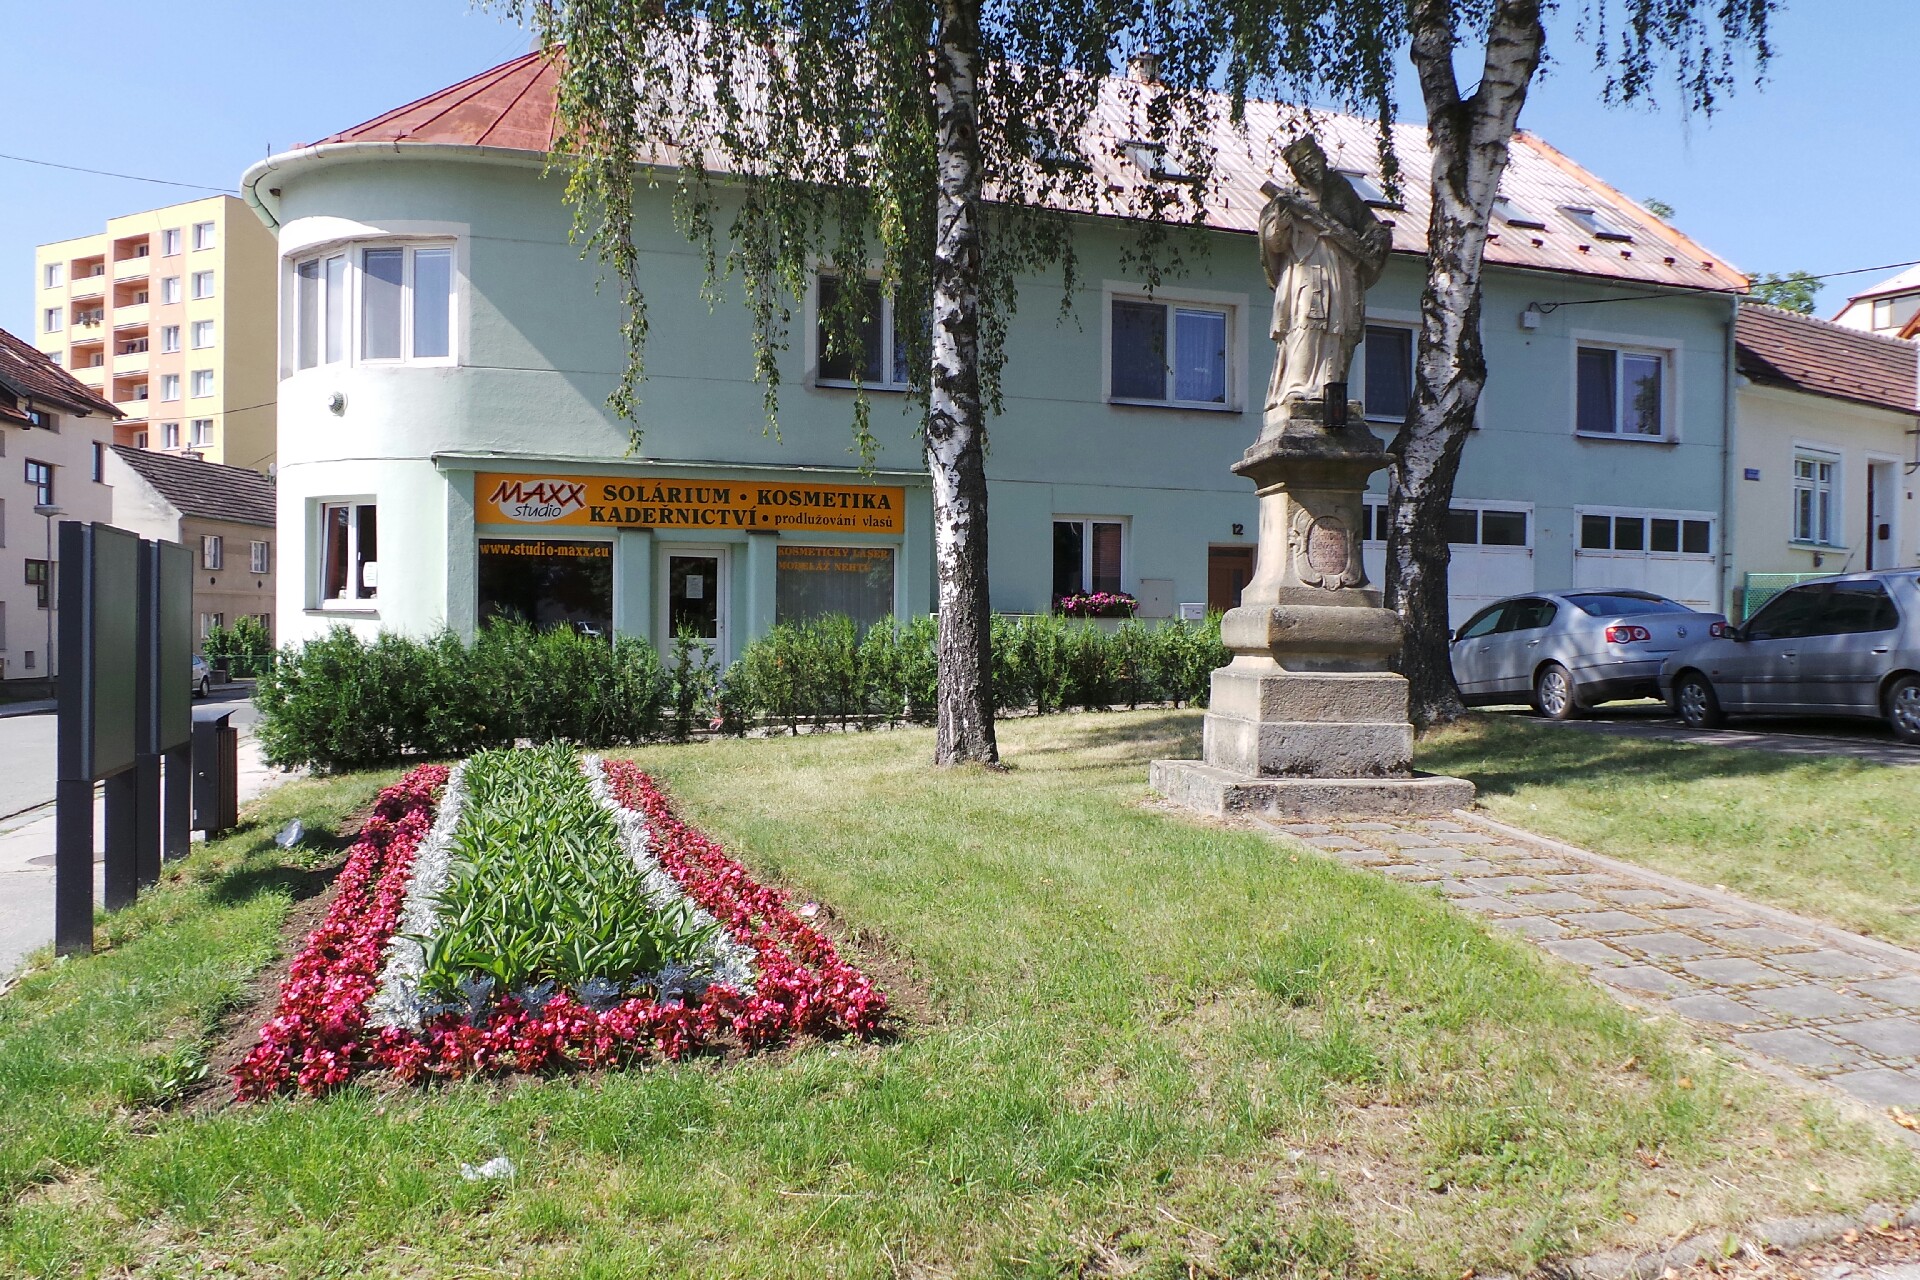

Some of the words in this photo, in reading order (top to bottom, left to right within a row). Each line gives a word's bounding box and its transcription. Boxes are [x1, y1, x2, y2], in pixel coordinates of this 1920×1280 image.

[489, 480, 587, 509] MAXX
[603, 482, 730, 504] SOLÁRIUM
[757, 489, 891, 509] KOSMETIKA
[513, 503, 561, 518] studio
[589, 504, 757, 525] KADEŘNICTVÍ
[774, 512, 856, 526] prodlužování
[862, 514, 893, 527] vlasů
[1232, 523, 1244, 535] 12
[480, 542, 609, 557] www.studio-maxx.eu
